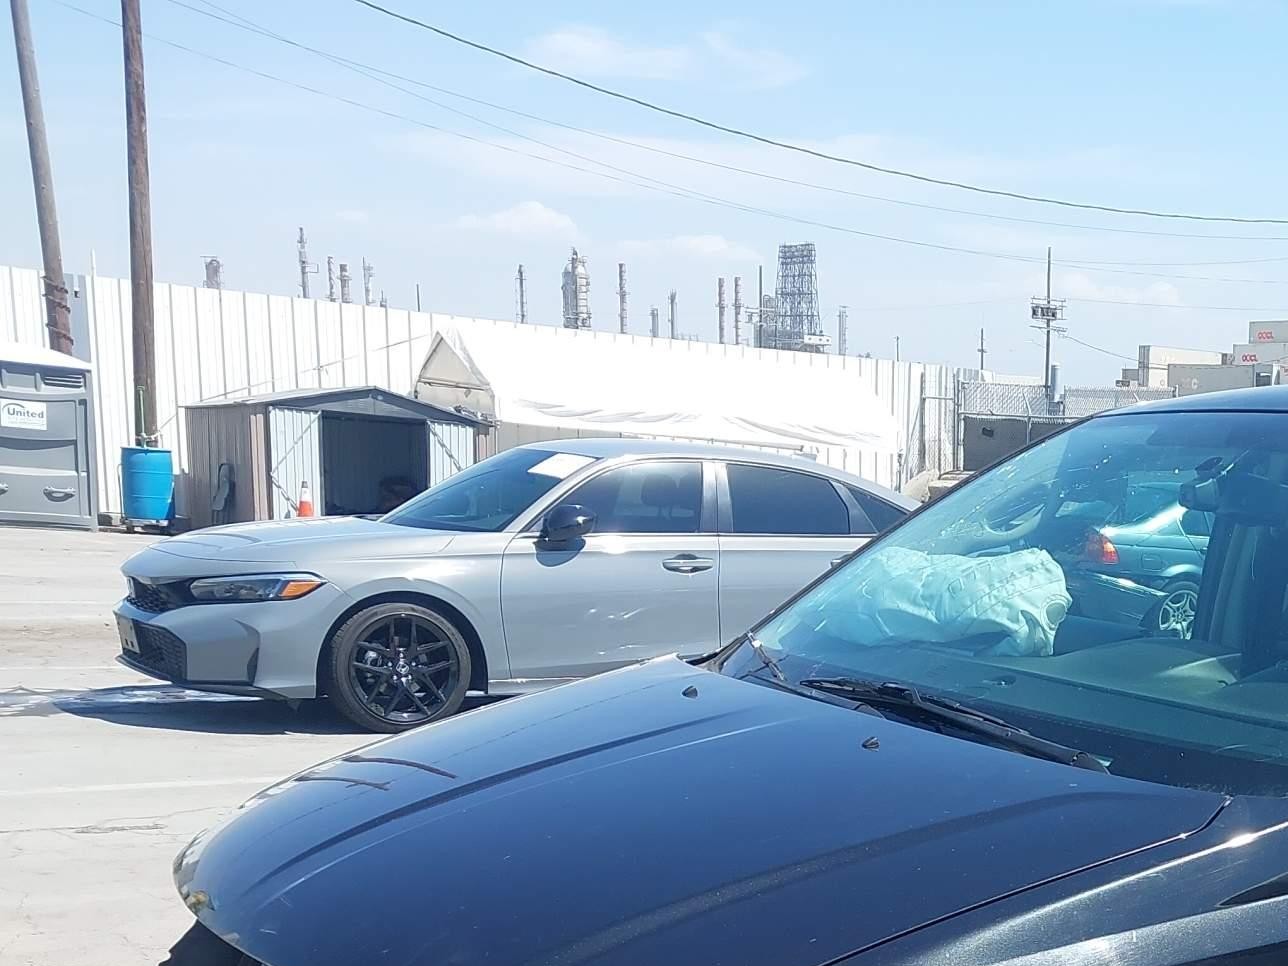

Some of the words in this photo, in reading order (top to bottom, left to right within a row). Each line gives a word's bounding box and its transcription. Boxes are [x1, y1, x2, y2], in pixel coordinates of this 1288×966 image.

[1257, 331, 1274, 340] OOCL
[1241, 353, 1258, 362] OOCL
[7, 407, 44, 418] United
